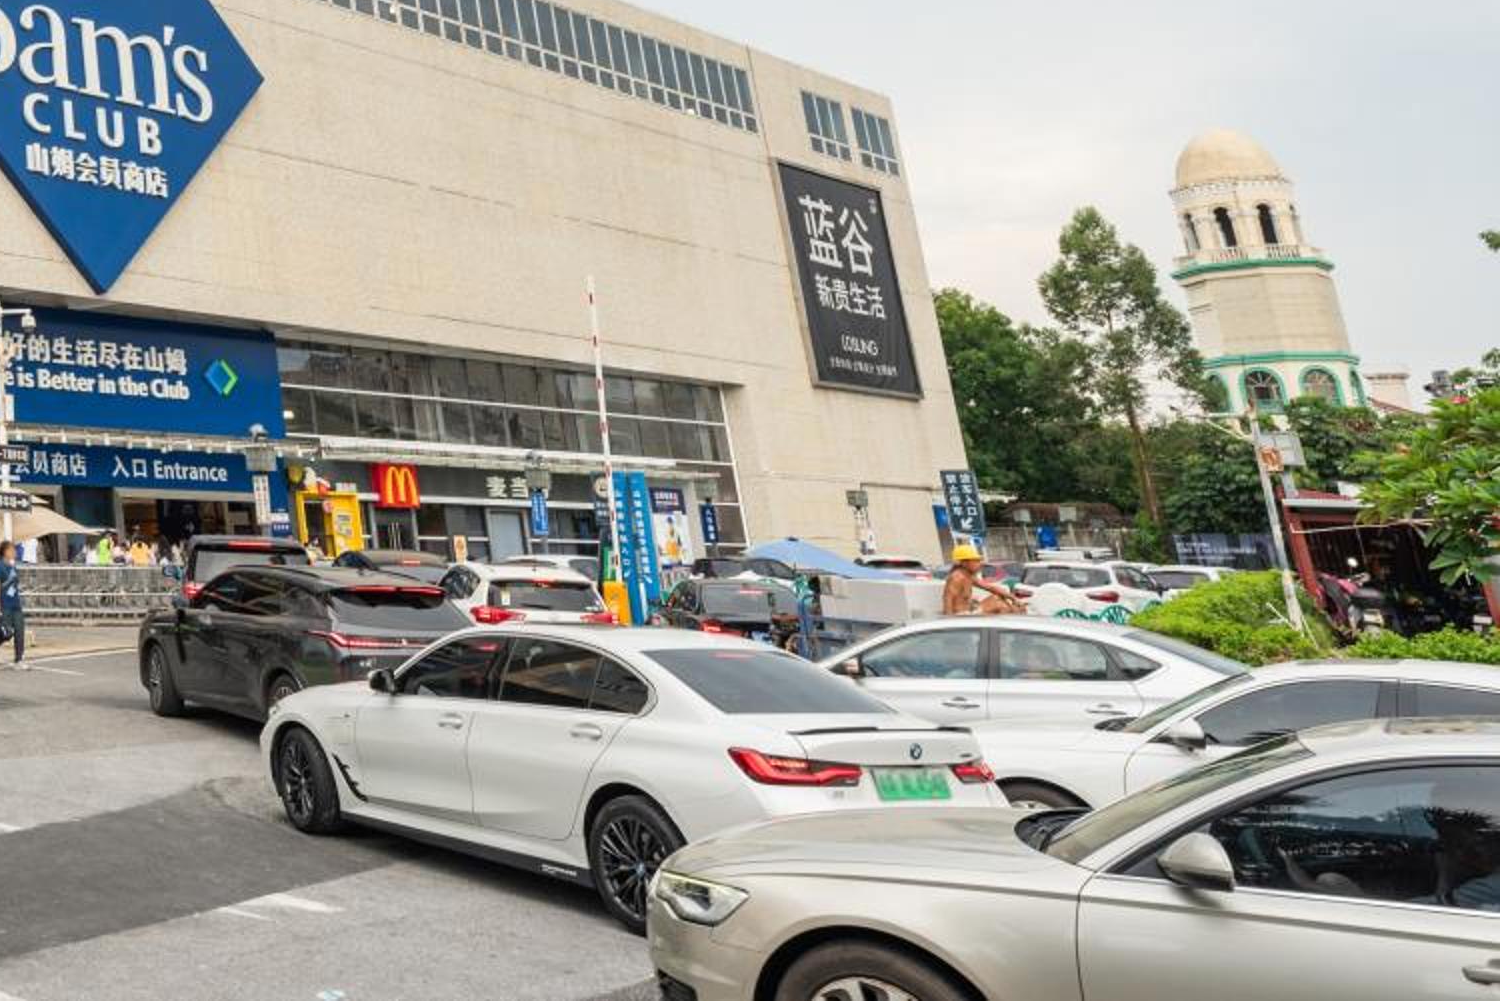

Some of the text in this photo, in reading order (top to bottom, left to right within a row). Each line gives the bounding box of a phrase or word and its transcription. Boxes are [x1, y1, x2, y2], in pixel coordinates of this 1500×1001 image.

[23, 92, 163, 156] CLUB
[24, 141, 169, 199] 山姆会员商店
[798, 194, 875, 276] 蓝谷
[815, 272, 888, 321] 新贵生活
[16, 367, 35, 387] is
[37, 368, 96, 393] Better
[98, 373, 116, 394] in
[118, 375, 149, 397] the
[150, 378, 191, 400] Club
[112, 458, 148, 479] 入口
[153, 459, 229, 483] Entrance
